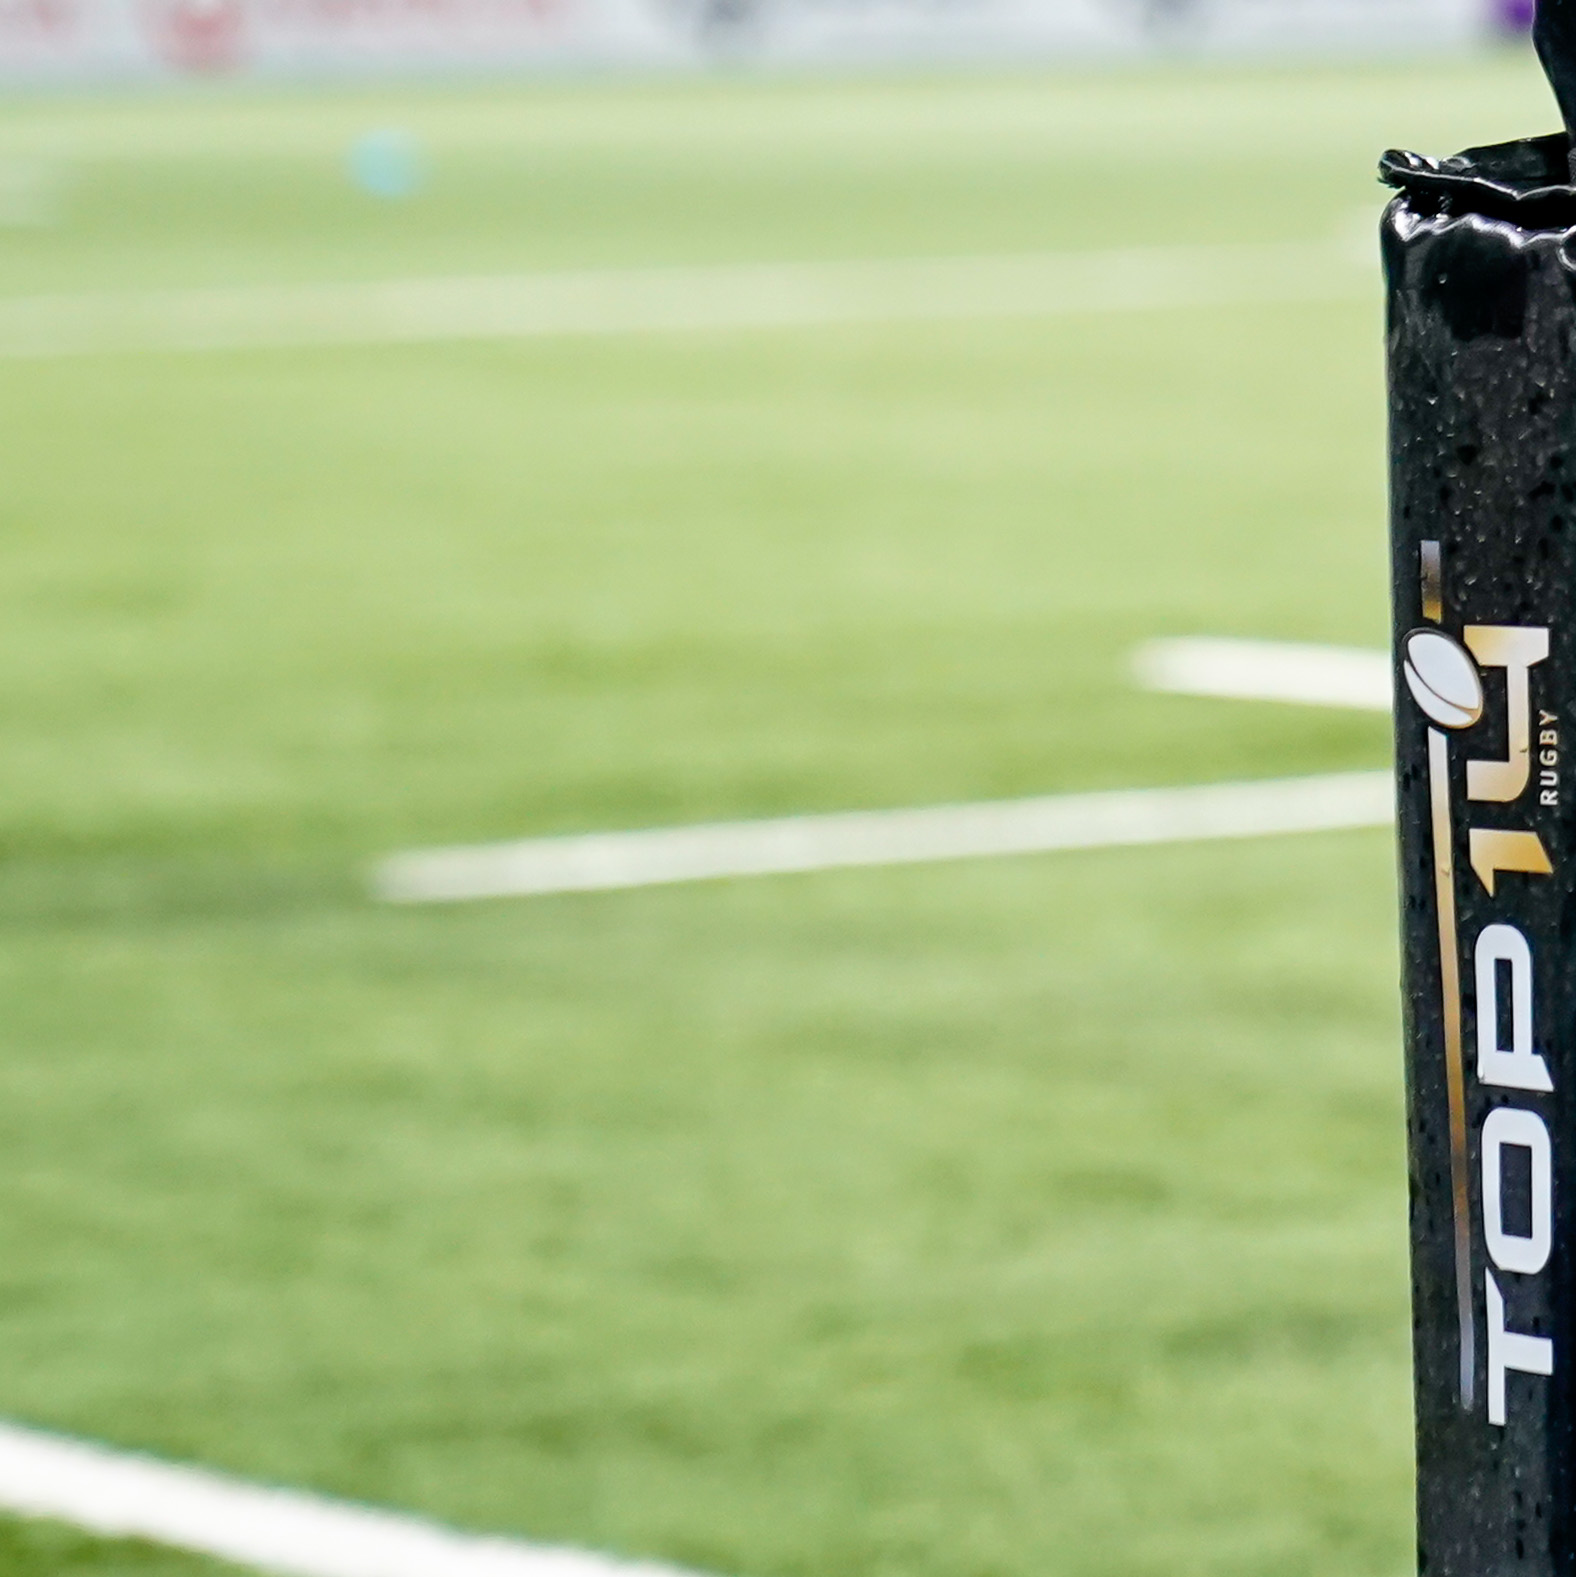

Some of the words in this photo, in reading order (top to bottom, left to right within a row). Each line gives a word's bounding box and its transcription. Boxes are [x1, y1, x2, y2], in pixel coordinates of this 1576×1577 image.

[1464, 627, 1553, 895] 14
[1540, 710, 1559, 805] RUGBY
[1476, 924, 1553, 1424] TOP
